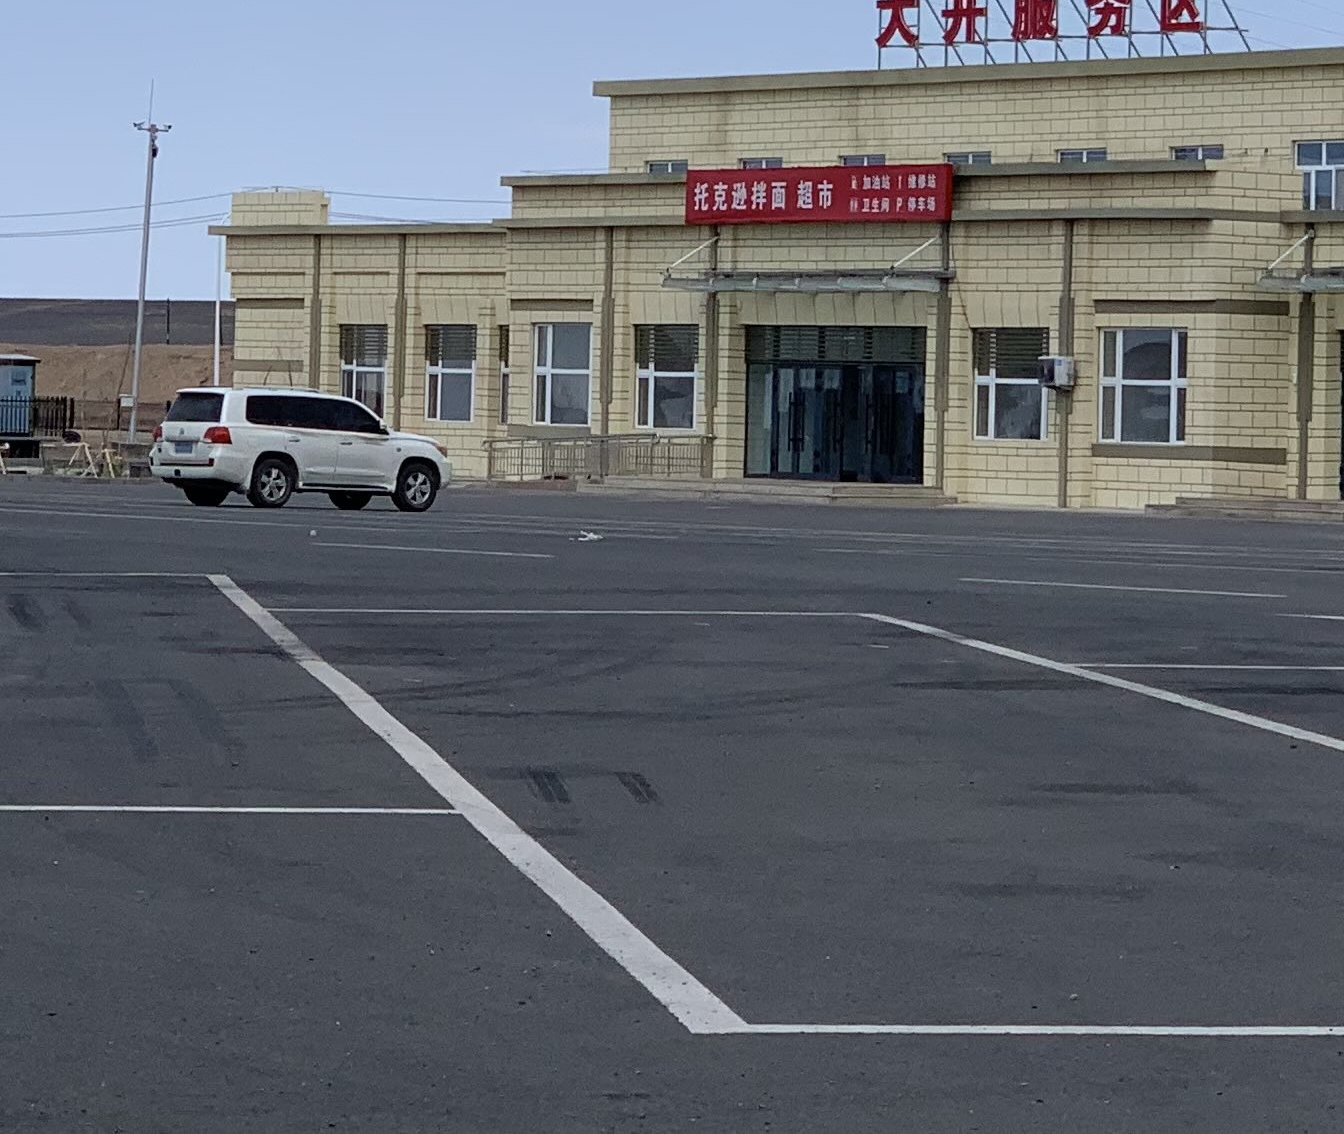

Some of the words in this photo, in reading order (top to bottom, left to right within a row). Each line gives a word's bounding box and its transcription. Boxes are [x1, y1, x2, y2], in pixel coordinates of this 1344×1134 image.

[862, 174, 891, 190] 加油站
[694, 181, 787, 211] 托克逊拌面
[796, 179, 834, 209] 超市
[861, 197, 890, 213] 卫生间
[907, 196, 936, 212] 停车场
